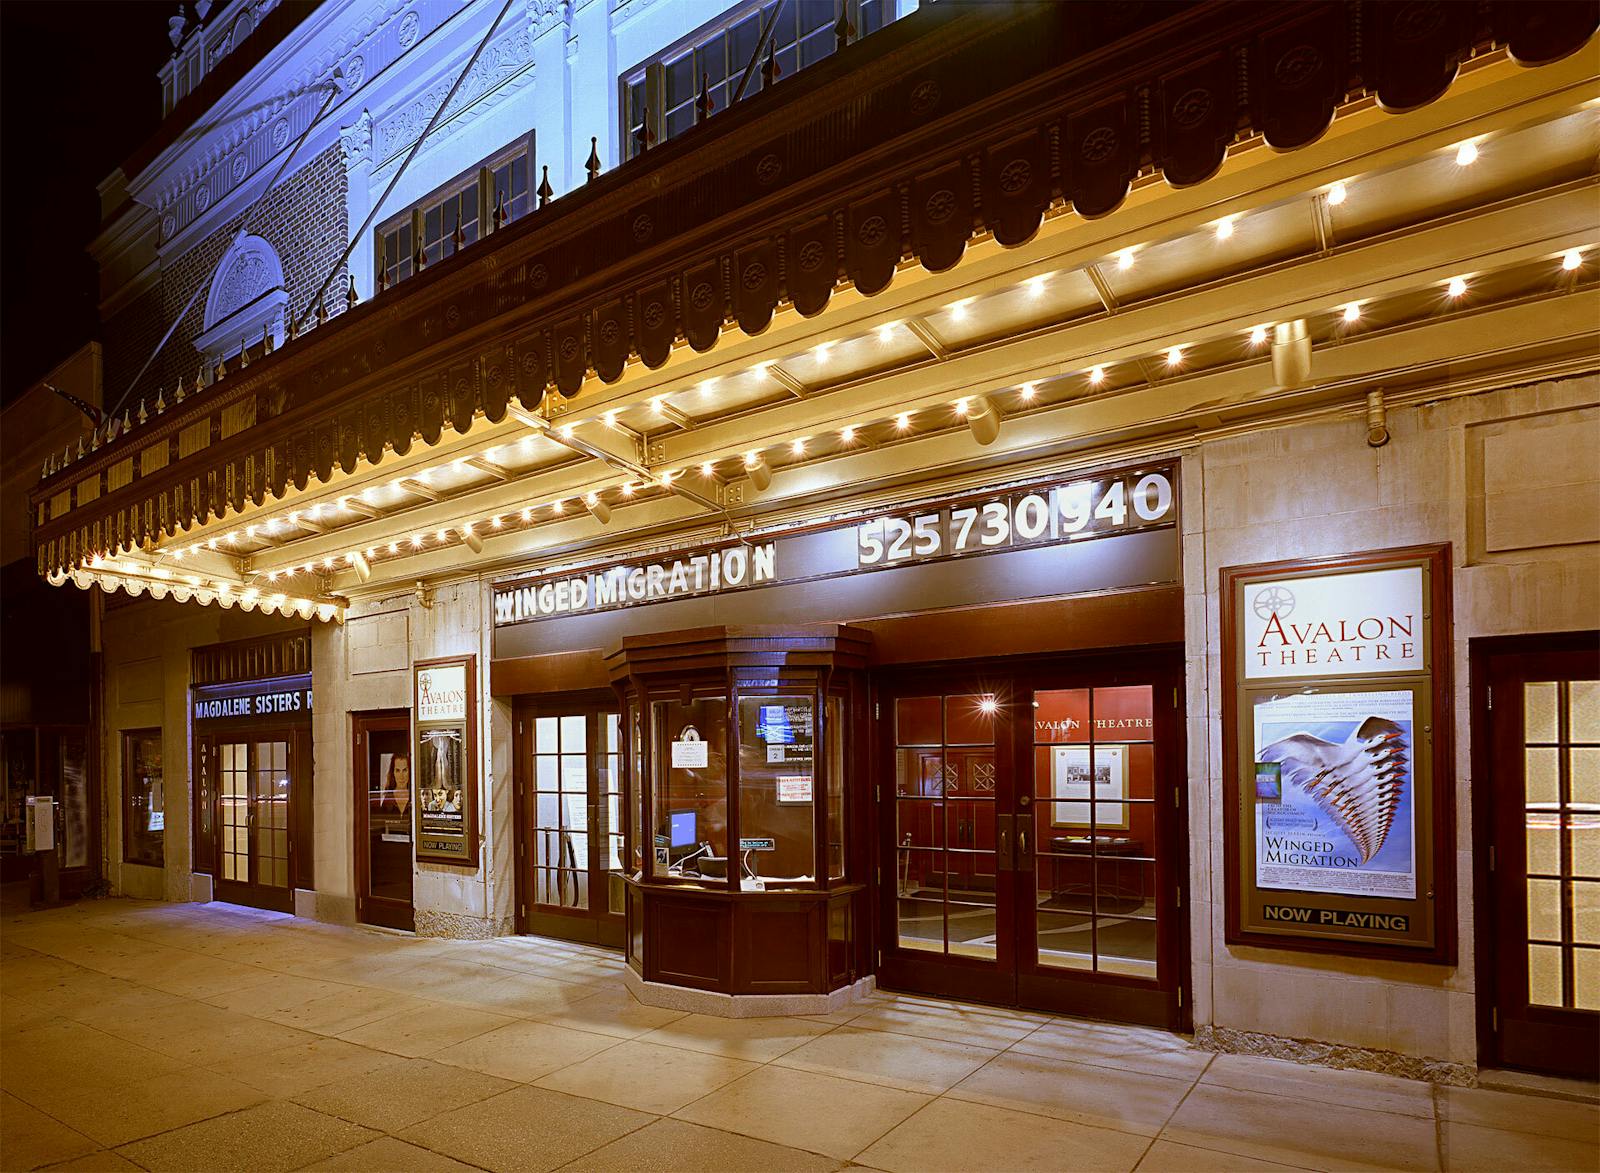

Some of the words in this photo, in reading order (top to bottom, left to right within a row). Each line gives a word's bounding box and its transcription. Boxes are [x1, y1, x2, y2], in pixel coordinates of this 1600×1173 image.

[495, 578, 588, 623] WINGED
[595, 543, 775, 606] MIGRATION
[859, 515, 941, 564] 525
[951, 495, 1049, 550] 730
[1057, 473, 1172, 534] 940
[1257, 611, 1414, 647] AVALON
[1257, 642, 1415, 667] THEATRE
[195, 698, 250, 719] MAGDALENE
[255, 691, 301, 714] SISTERS
[421, 686, 464, 705] AVALON
[420, 703, 464, 715] THEATRE
[200, 743, 208, 810] AVALON
[423, 841, 437, 849] NOW
[438, 842, 463, 851] PLAYING
[1265, 836, 1334, 853] WINGED
[1265, 850, 1358, 868] MIGRATION
[1265, 906, 1312, 922] NOW
[1319, 910, 1407, 931] PLAYING
